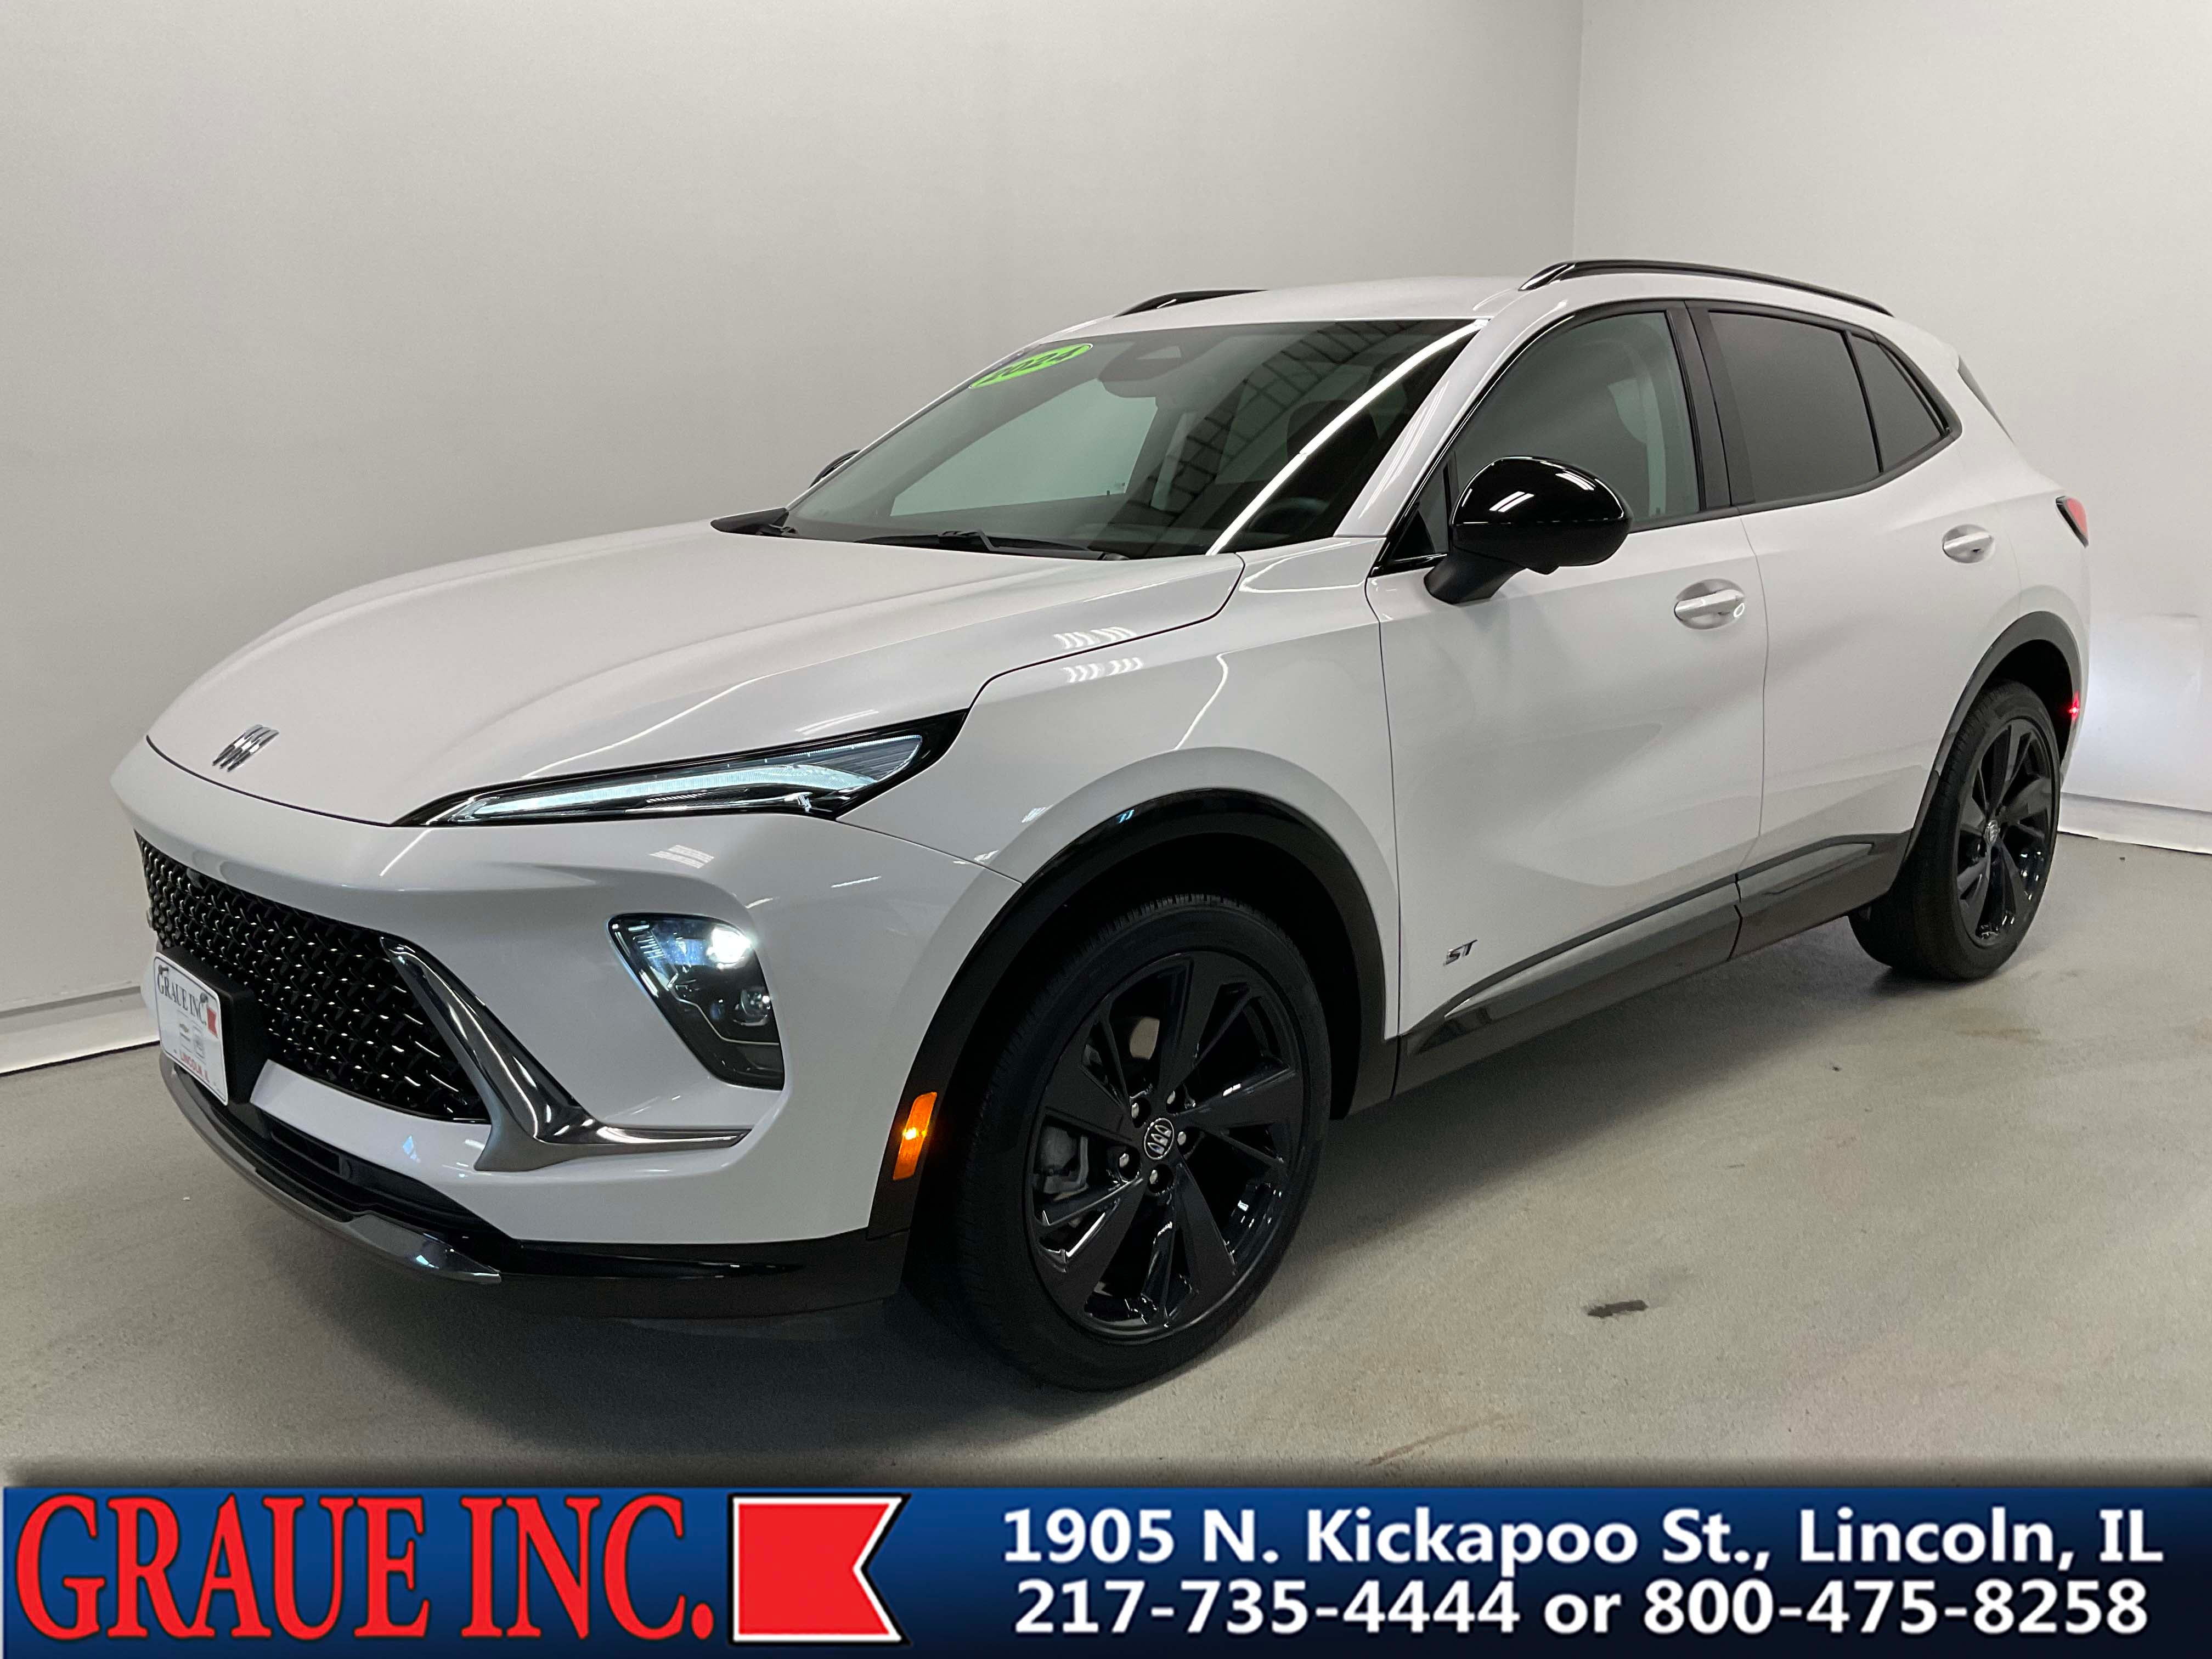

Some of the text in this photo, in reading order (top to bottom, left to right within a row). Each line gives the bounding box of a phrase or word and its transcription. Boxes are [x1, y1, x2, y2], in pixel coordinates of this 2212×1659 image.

[973, 345, 1085, 386] 2024
[1443, 939, 1477, 966] ST
[157, 973, 188, 1012] GRAUE
